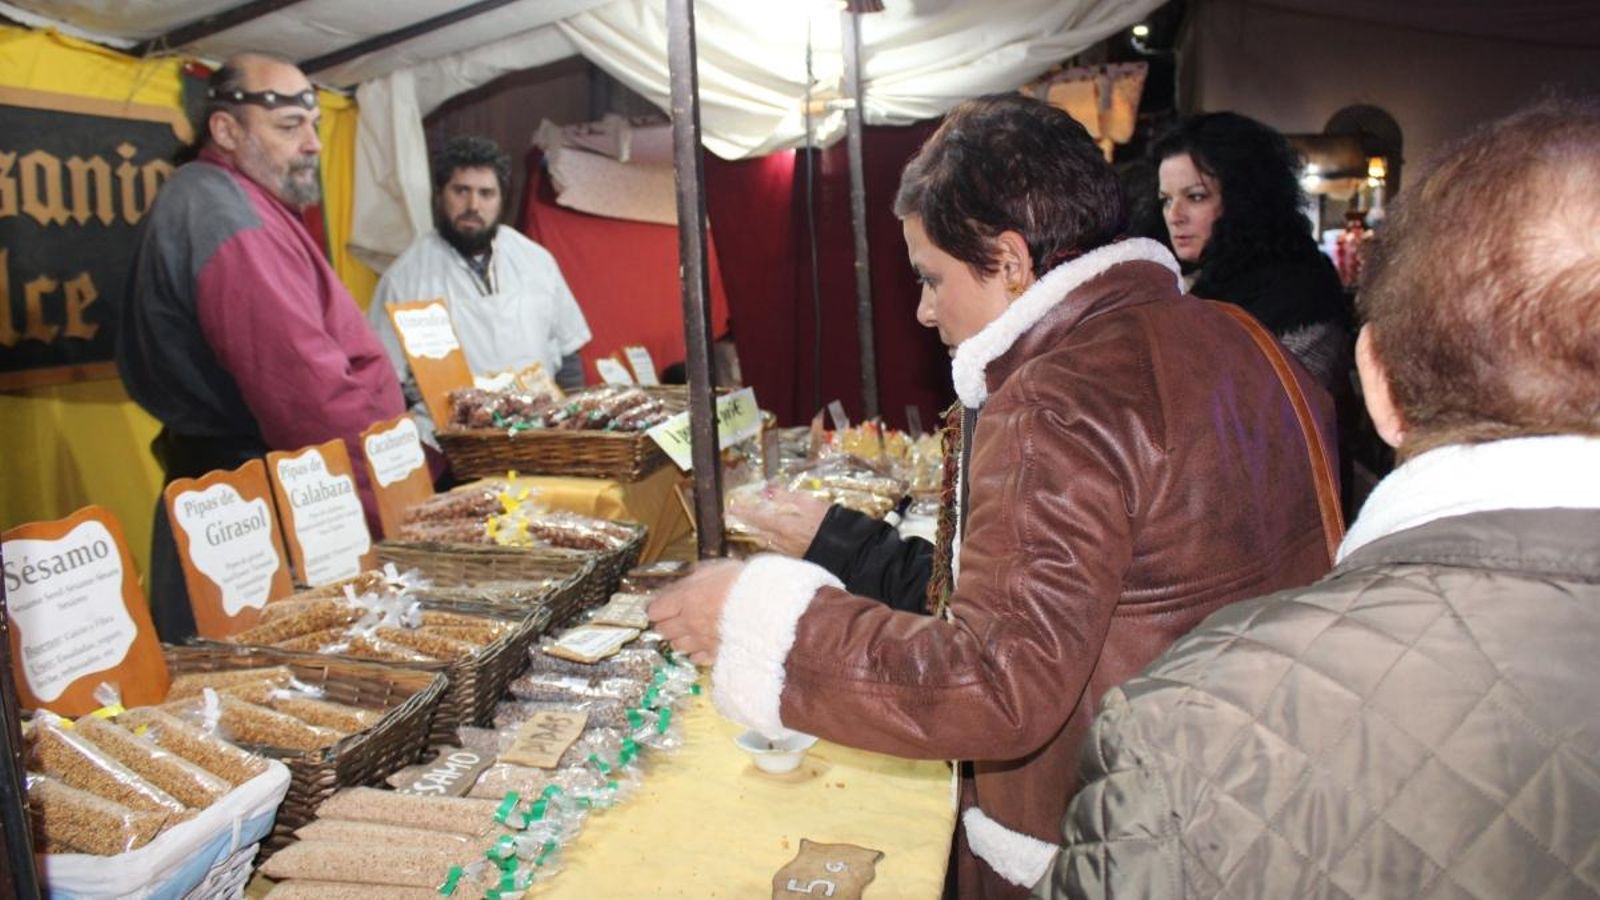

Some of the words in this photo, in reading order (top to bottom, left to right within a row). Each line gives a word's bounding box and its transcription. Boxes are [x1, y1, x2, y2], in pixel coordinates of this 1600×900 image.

[183, 498, 218, 518] Pipas
[220, 489, 235, 506] de
[290, 480, 352, 509] Calabaza
[205, 505, 267, 547] Girasol
[4, 539, 109, 592] Sésamo
